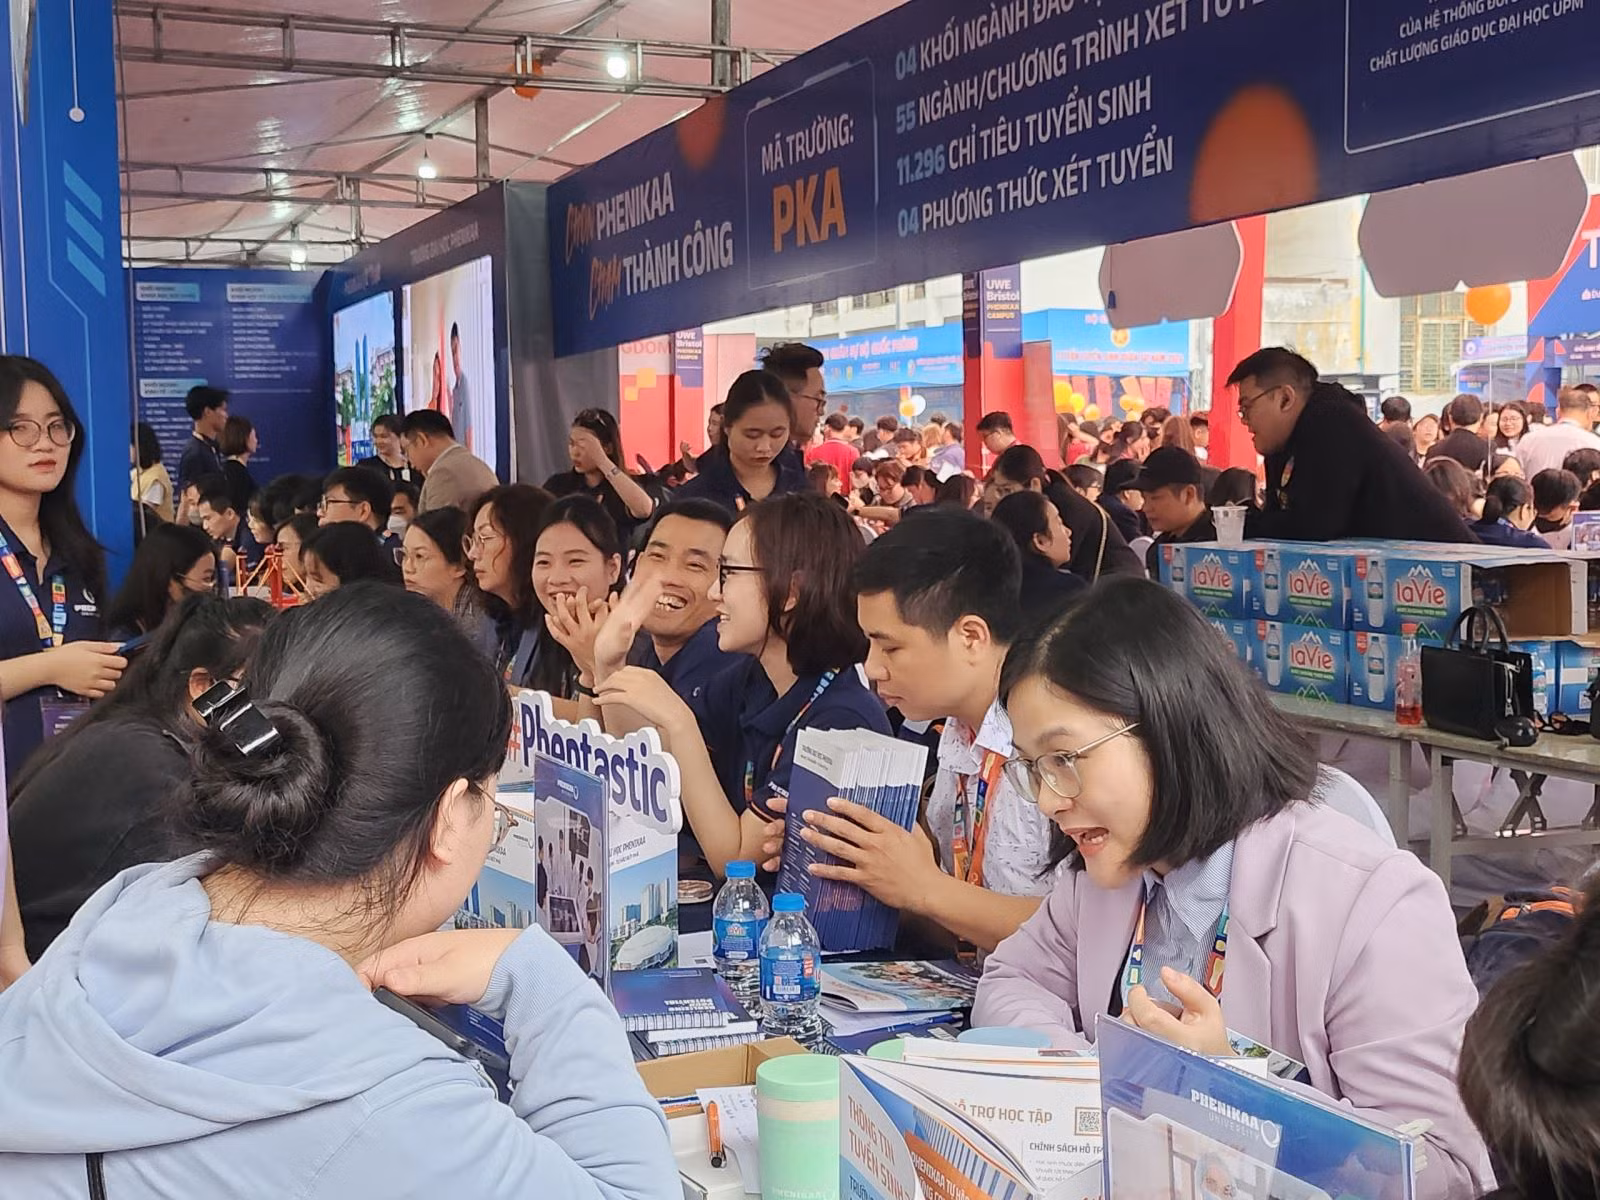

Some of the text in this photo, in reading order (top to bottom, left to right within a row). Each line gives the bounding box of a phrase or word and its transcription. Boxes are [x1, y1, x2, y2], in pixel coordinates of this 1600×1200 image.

[895, 45, 917, 80] 04
[919, 17, 960, 71] KHỐI
[1369, 48, 1398, 72] CHẤT
[1399, 38, 1439, 64] LƯỢNG
[1440, 28, 1469, 51] GIÁO
[1471, 20, 1496, 44] DỤC
[1498, 12, 1521, 34] ĐẠI
[1523, 4, 1550, 27] HỌC
[1399, 16, 1422, 39] CỦA
[896, 101, 915, 134] 55
[918, 42, 1067, 127] NGÀNH/CHƯƠNG
[1071, 14, 1139, 71] TRÌNH
[761, 112, 855, 176] MÃ TRƯỜNG:
[896, 75, 1151, 186] 11.296 CHỈ TIÊU TUYỂN SINH
[596, 171, 675, 241] PHENIKAA
[772, 166, 848, 253] PKA
[898, 125, 1173, 238] 04 PHƯƠNG THỨC XÉT TUYỂN
[622, 239, 680, 296] THÀNH
[682, 219, 734, 279] CÔNG
[986, 279, 1012, 290] UWE
[986, 290, 1020, 301] Bristol
[847, 1095, 895, 1166] THÔNG TIN
[970, 1104, 995, 1121] TRỢ
[998, 1107, 1025, 1124] HỌC
[1028, 1108, 1053, 1126] TẬP
[1190, 1088, 1260, 1131] PHENIKAA
[848, 1128, 879, 1178] TUYỂN
